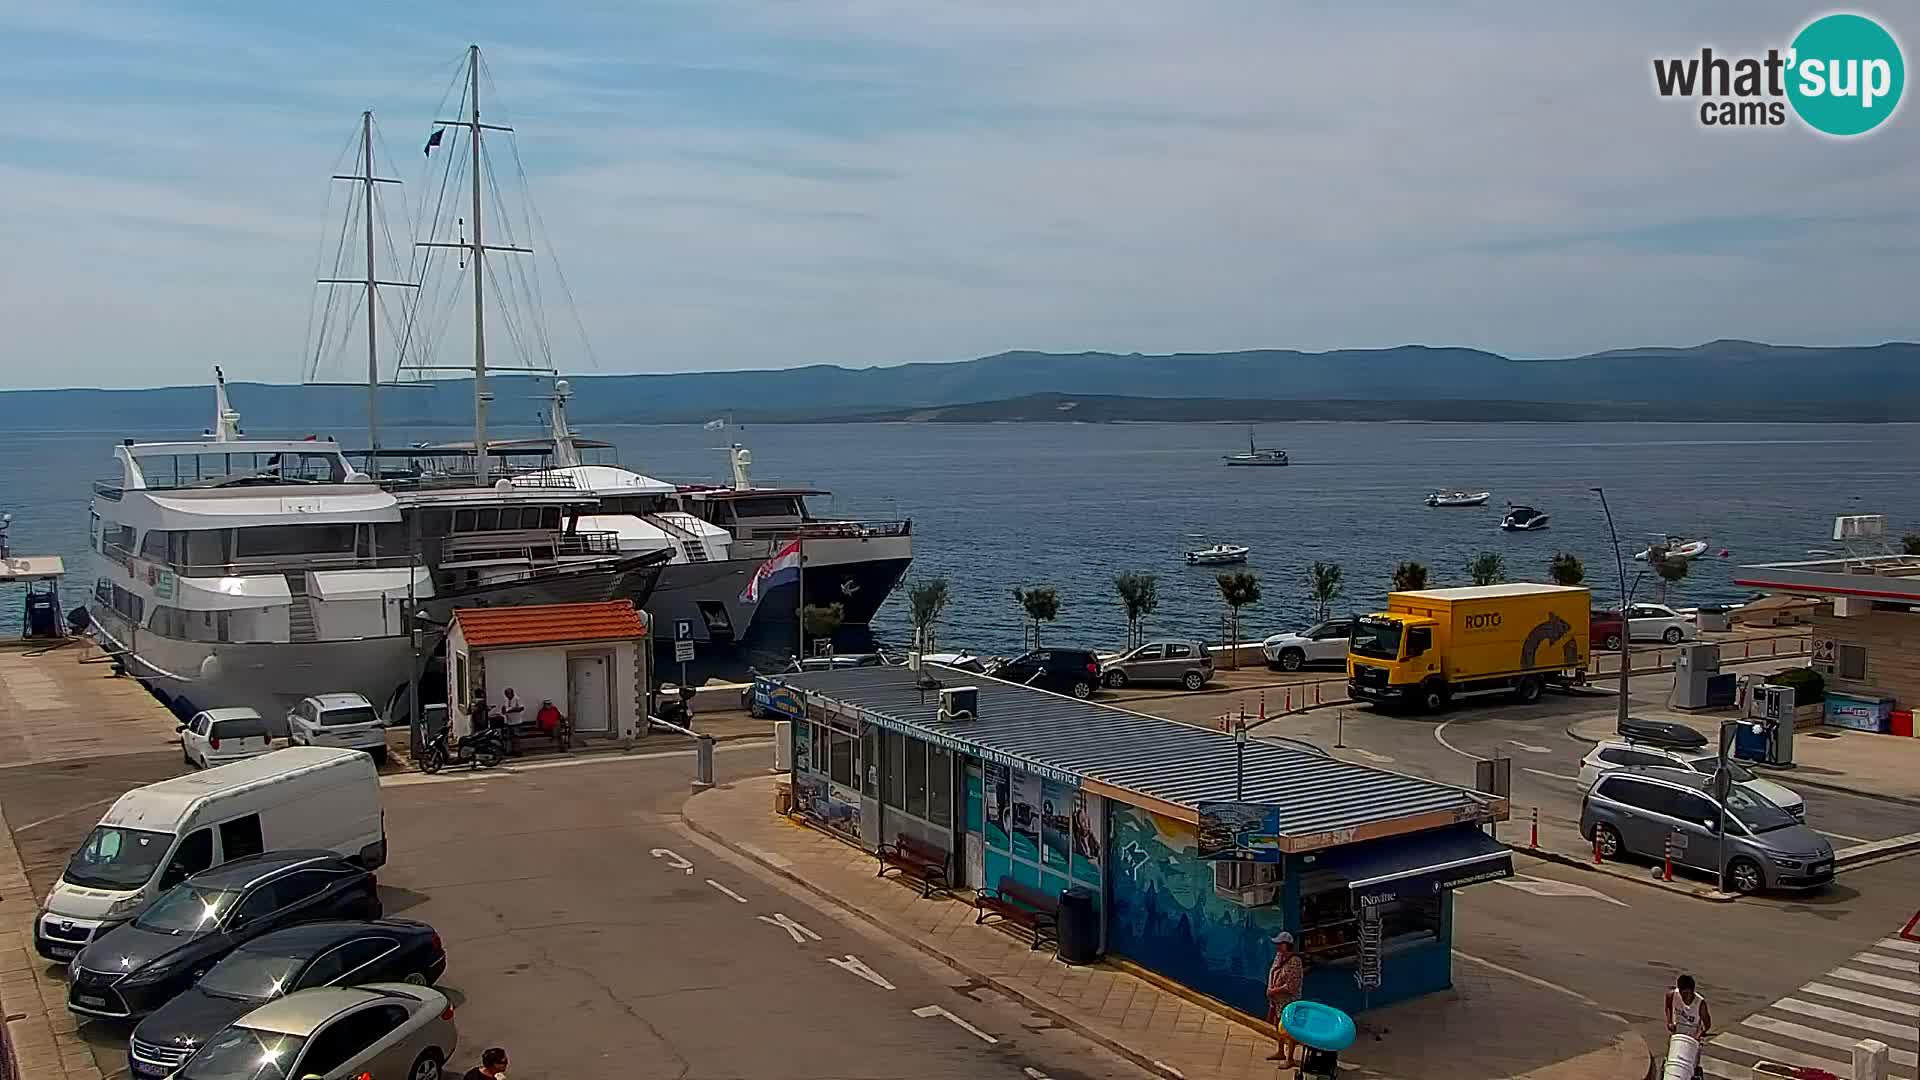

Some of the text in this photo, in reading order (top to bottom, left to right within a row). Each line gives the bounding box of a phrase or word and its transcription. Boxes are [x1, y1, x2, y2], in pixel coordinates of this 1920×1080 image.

[1465, 612, 1502, 629] ROTO
[679, 622, 689, 638] P
[979, 747, 993, 760] BUS
[994, 751, 1025, 770] STATION
[1026, 762, 1051, 778] TICKET
[1051, 769, 1077, 785] OFFICE
